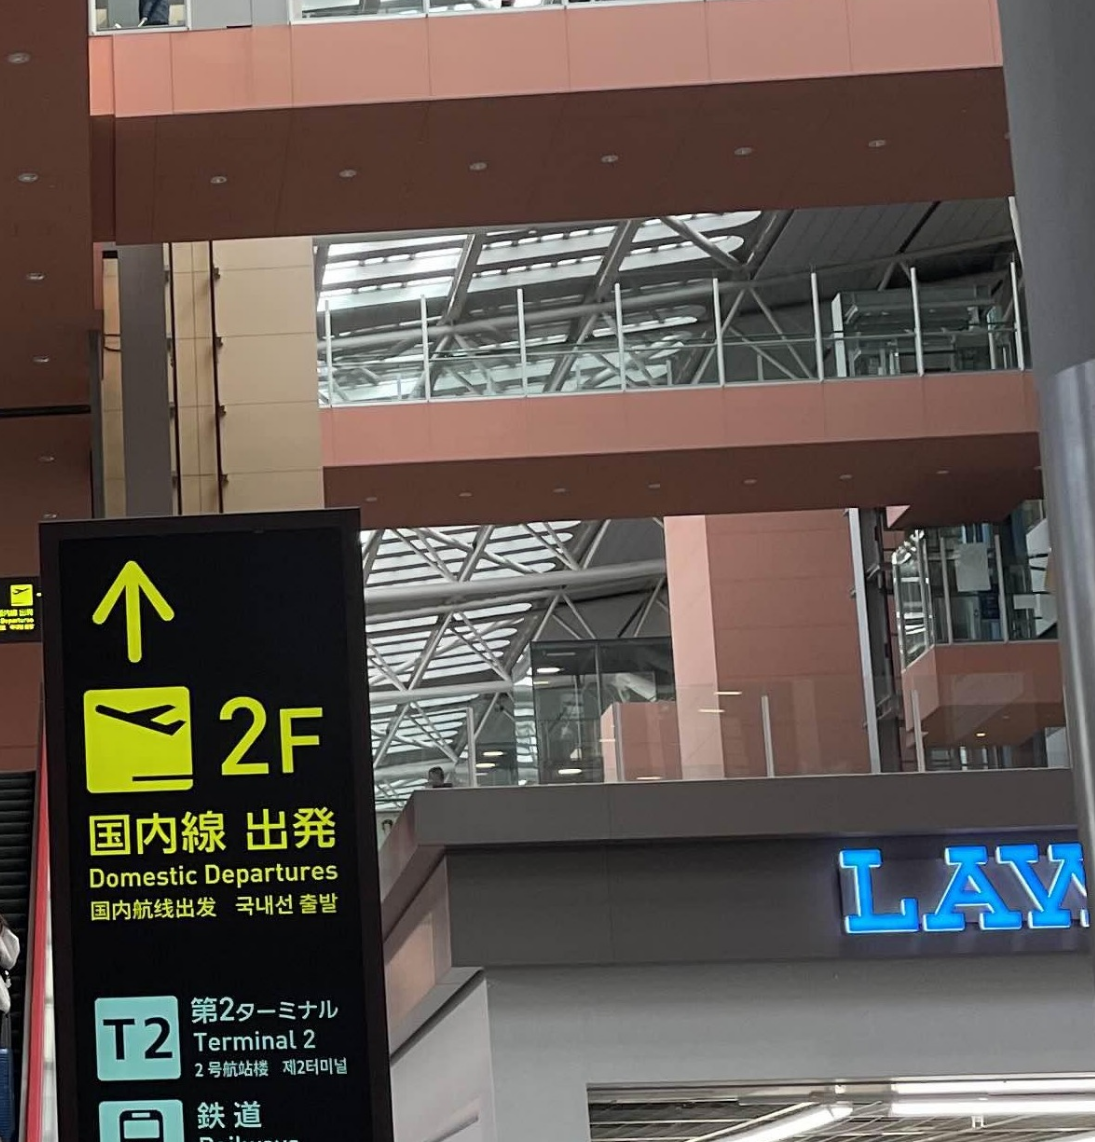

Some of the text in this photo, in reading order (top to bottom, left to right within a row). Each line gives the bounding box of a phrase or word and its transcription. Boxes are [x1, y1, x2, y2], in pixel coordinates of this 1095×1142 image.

[219, 696, 324, 776] 2F
[89, 807, 336, 856] 国内線 出発
[89, 862, 338, 888] Domestic Departures
[90, 897, 217, 921] 国内航线出发
[235, 892, 338, 916] 국내선 출발
[190, 996, 339, 1024] 第2ターミナル
[103, 1016, 173, 1061] T2
[193, 1029, 316, 1052] Terminal 2
[282, 1057, 348, 1076] 제2터미널
